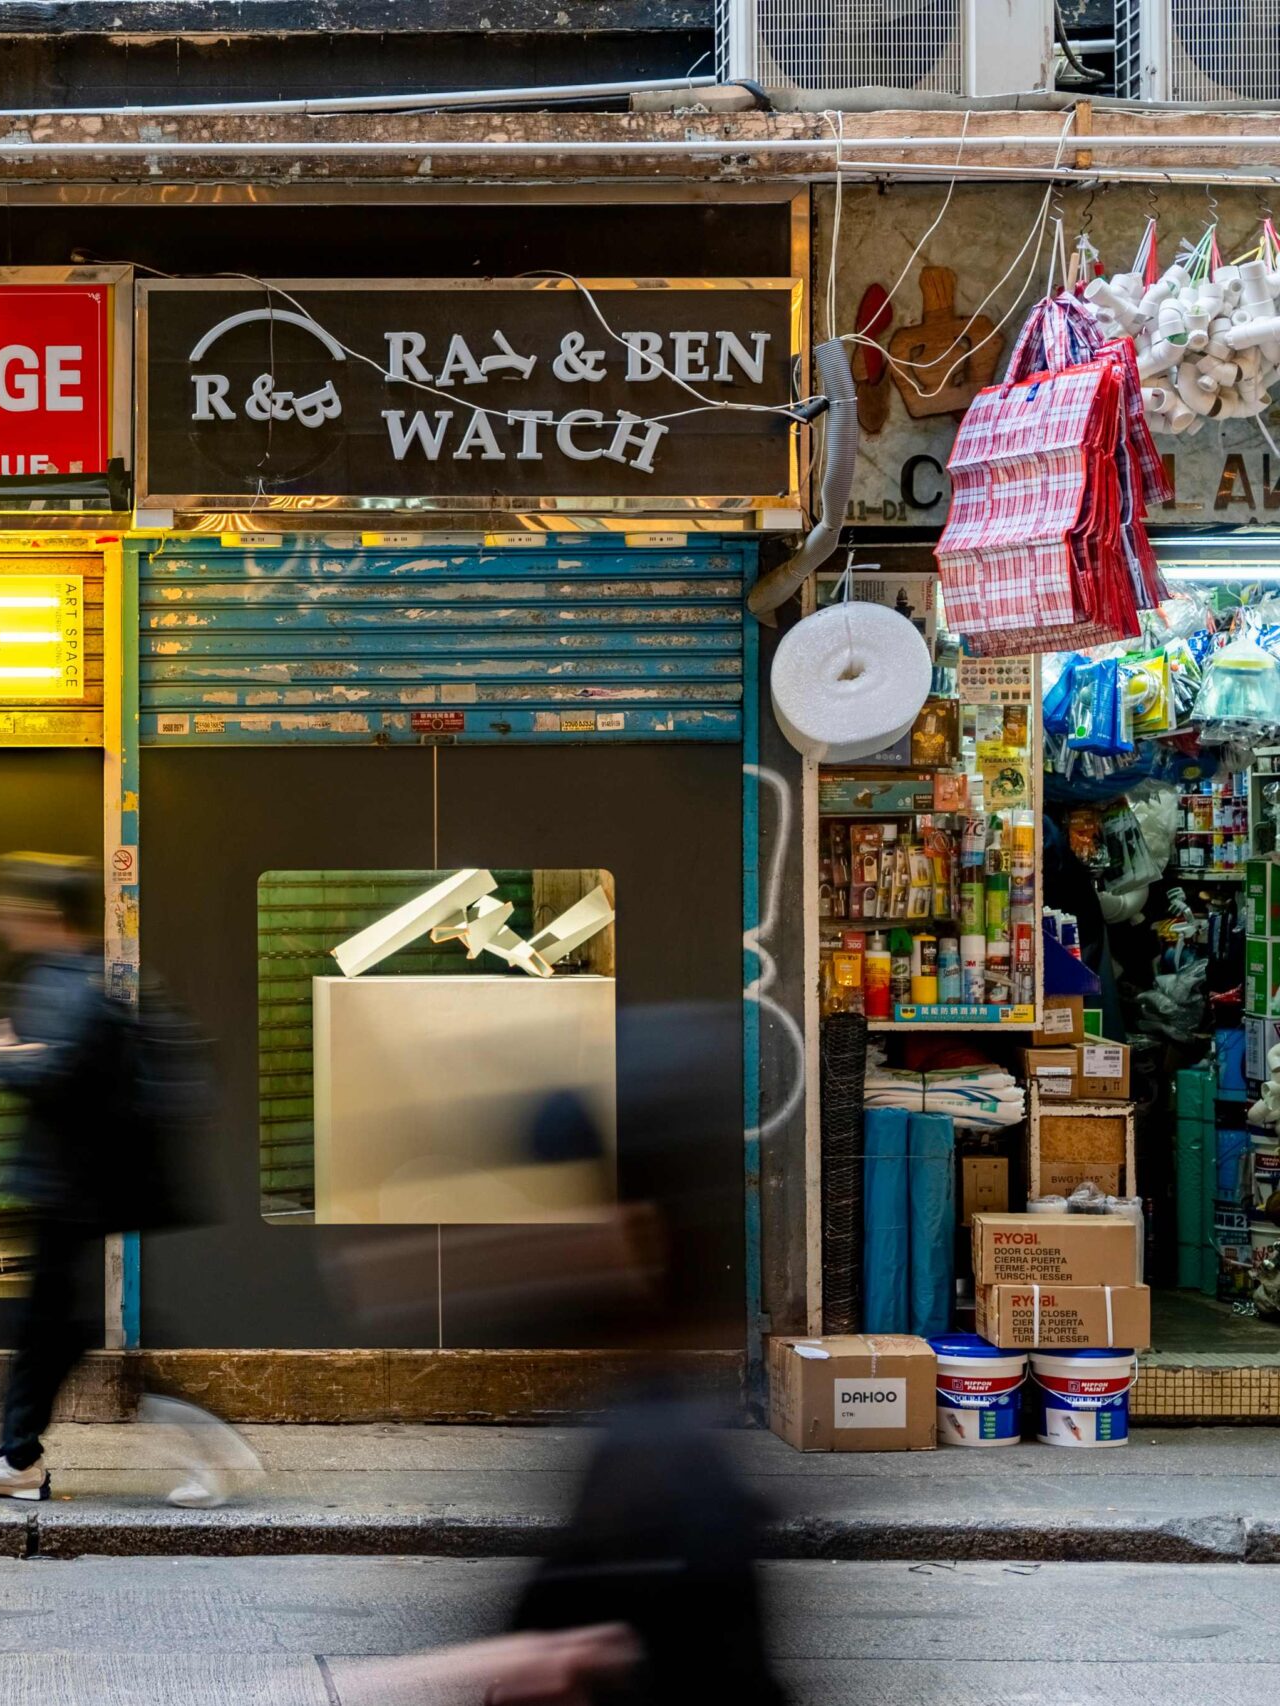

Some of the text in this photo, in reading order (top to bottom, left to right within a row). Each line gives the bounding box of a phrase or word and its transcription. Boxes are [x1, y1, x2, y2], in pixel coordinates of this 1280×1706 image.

[384, 329, 771, 386] RAY & BEN
[381, 408, 669, 474] WATCH
[65, 583, 78, 687] ART SPACE
[966, 960, 976, 968] 3M
[993, 1232, 1038, 1245] RYOBI
[994, 1247, 1061, 1256] DOOR CLOSER
[994, 1256, 1067, 1264] CIERRA PUERTA
[1012, 1310, 1078, 1318] DOO CLOSER
[841, 1391, 898, 1404] DAHOO
